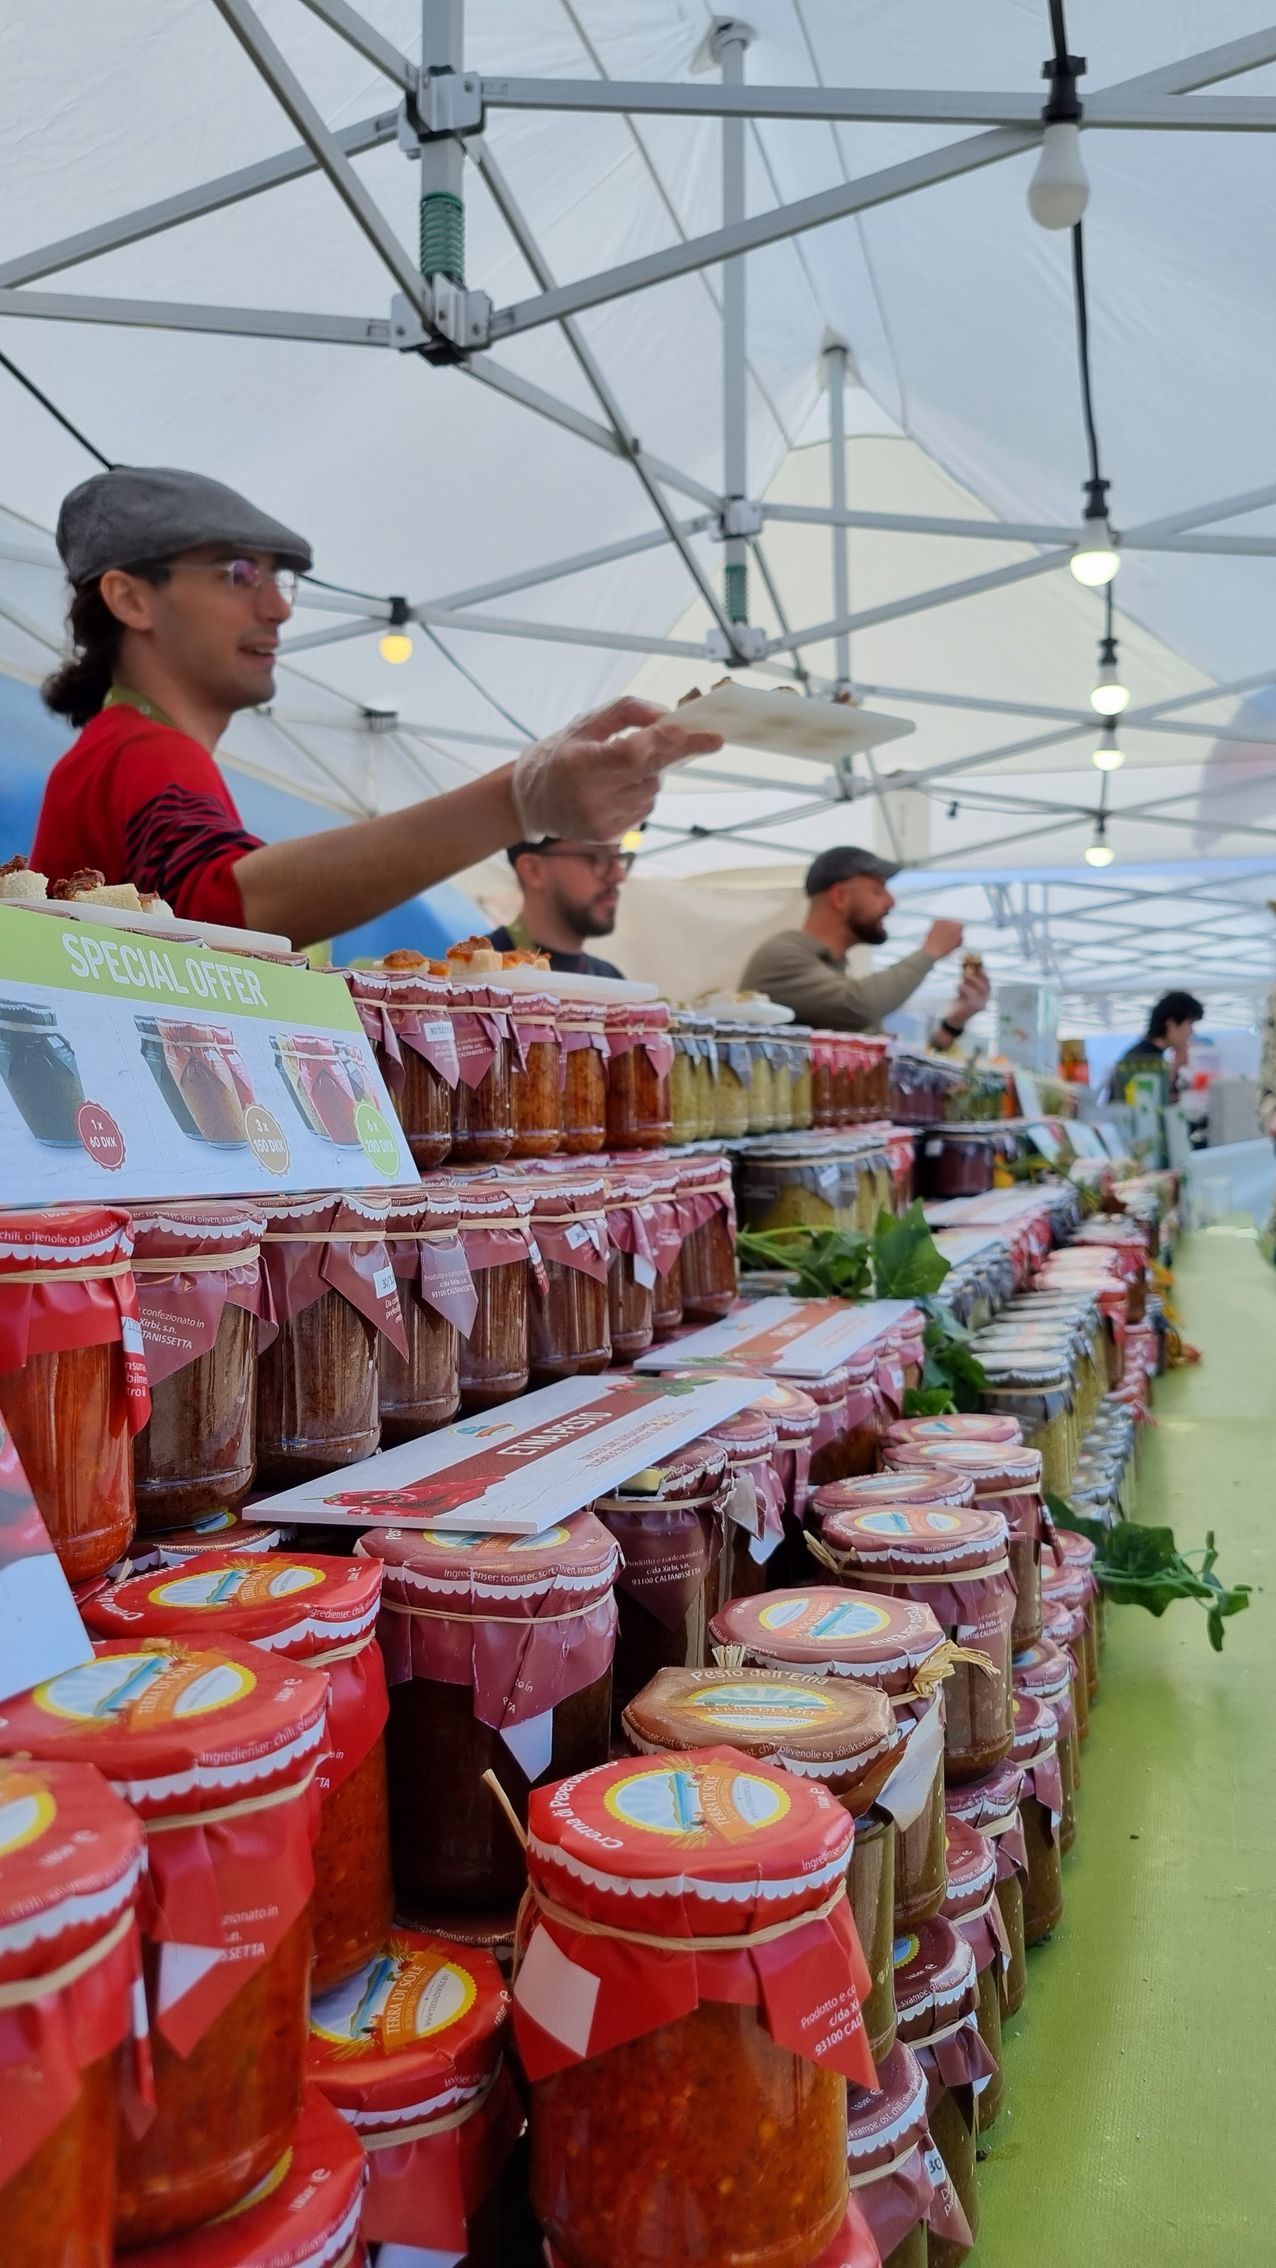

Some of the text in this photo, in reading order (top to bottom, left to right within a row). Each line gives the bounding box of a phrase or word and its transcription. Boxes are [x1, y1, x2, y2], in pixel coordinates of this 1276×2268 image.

[62, 933, 268, 1007] SPECIAL OFFER
[90, 1136, 118, 1147] 60 DKK
[268, 1139, 286, 1152] DKK
[181, 1213, 197, 1222] sort
[68, 1237, 80, 1246] og
[142, 1306, 196, 1328] confezionato
[196, 1320, 206, 1329] in
[163, 1324, 177, 1335] s.n.
[501, 1572, 538, 1583] tomater,
[631, 1567, 702, 1586] 93100 CALTANISSETTA
[690, 1667, 744, 1682] Pesto
[202, 1727, 299, 1764] Ingredienser: chili,
[822, 1751, 834, 1761] og
[550, 1760, 624, 1849] Crema di Peperoncino
[702, 1774, 731, 1826] TERRA DI SOLE
[399, 1964, 426, 1988] SOLE
[391, 1988, 409, 2001] DI
[386, 2002, 403, 2035] TERRA
[800, 1996, 839, 2030] Prodotto
[839, 1991, 846, 2002] e
[828, 2007, 850, 2027] c/da
[815, 2028, 843, 2056] 93100
